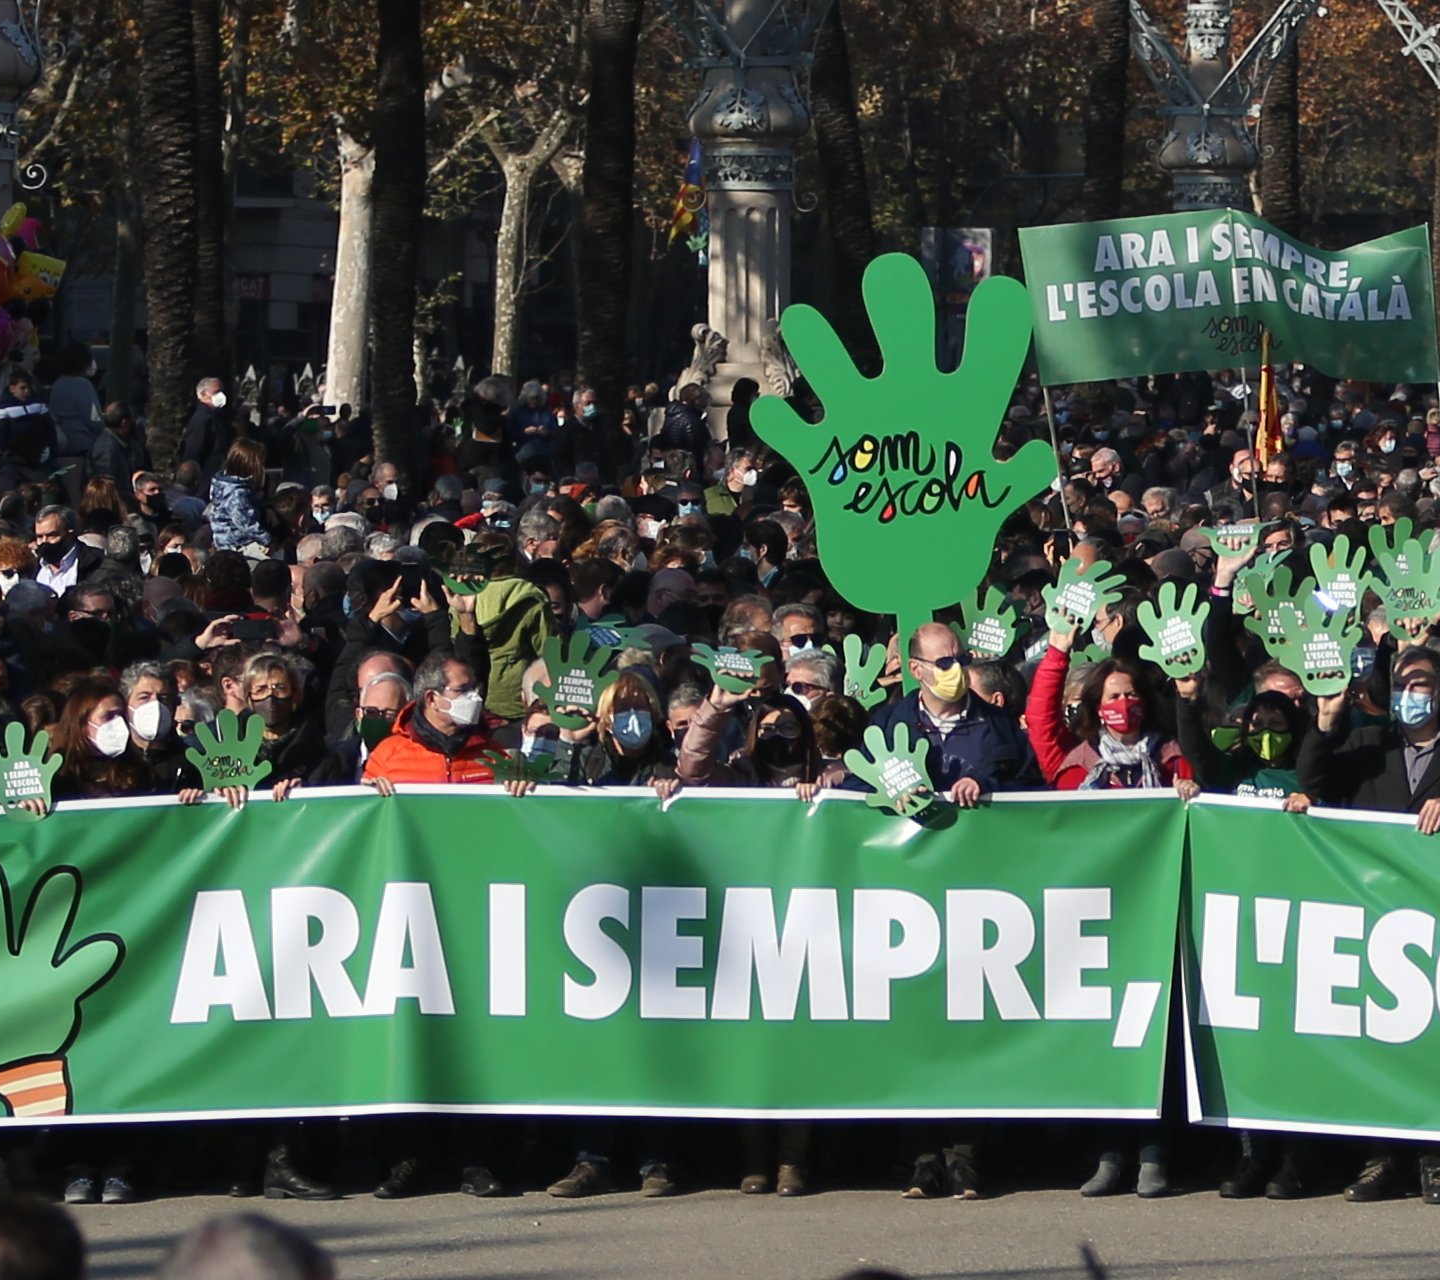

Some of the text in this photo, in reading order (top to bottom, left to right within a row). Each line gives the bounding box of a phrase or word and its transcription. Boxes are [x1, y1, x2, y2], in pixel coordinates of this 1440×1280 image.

[1094, 223, 1362, 290] ARA I SEMPRE,
[1046, 267, 1412, 321] L'ESCOLA EN CATALÀ
[808, 430, 936, 485] som
[843, 441, 1012, 524] escola
[985, 618, 999, 627] ARA
[968, 637, 978, 646] EN
[973, 631, 1002, 643] L'ESCOLA
[1306, 651, 1339, 659] L'ESCOLA
[1305, 661, 1314, 669] EN
[570, 669, 586, 678] ARA
[559, 684, 592, 695] L'ESCOLA
[555, 693, 566, 702] EN
[7, 778, 40, 788] L'ESCOLA
[5, 788, 15, 796] EN
[169, 881, 455, 1024] ARA
[488, 882, 528, 1018] I
[561, 882, 1162, 1048] SEMPRE,
